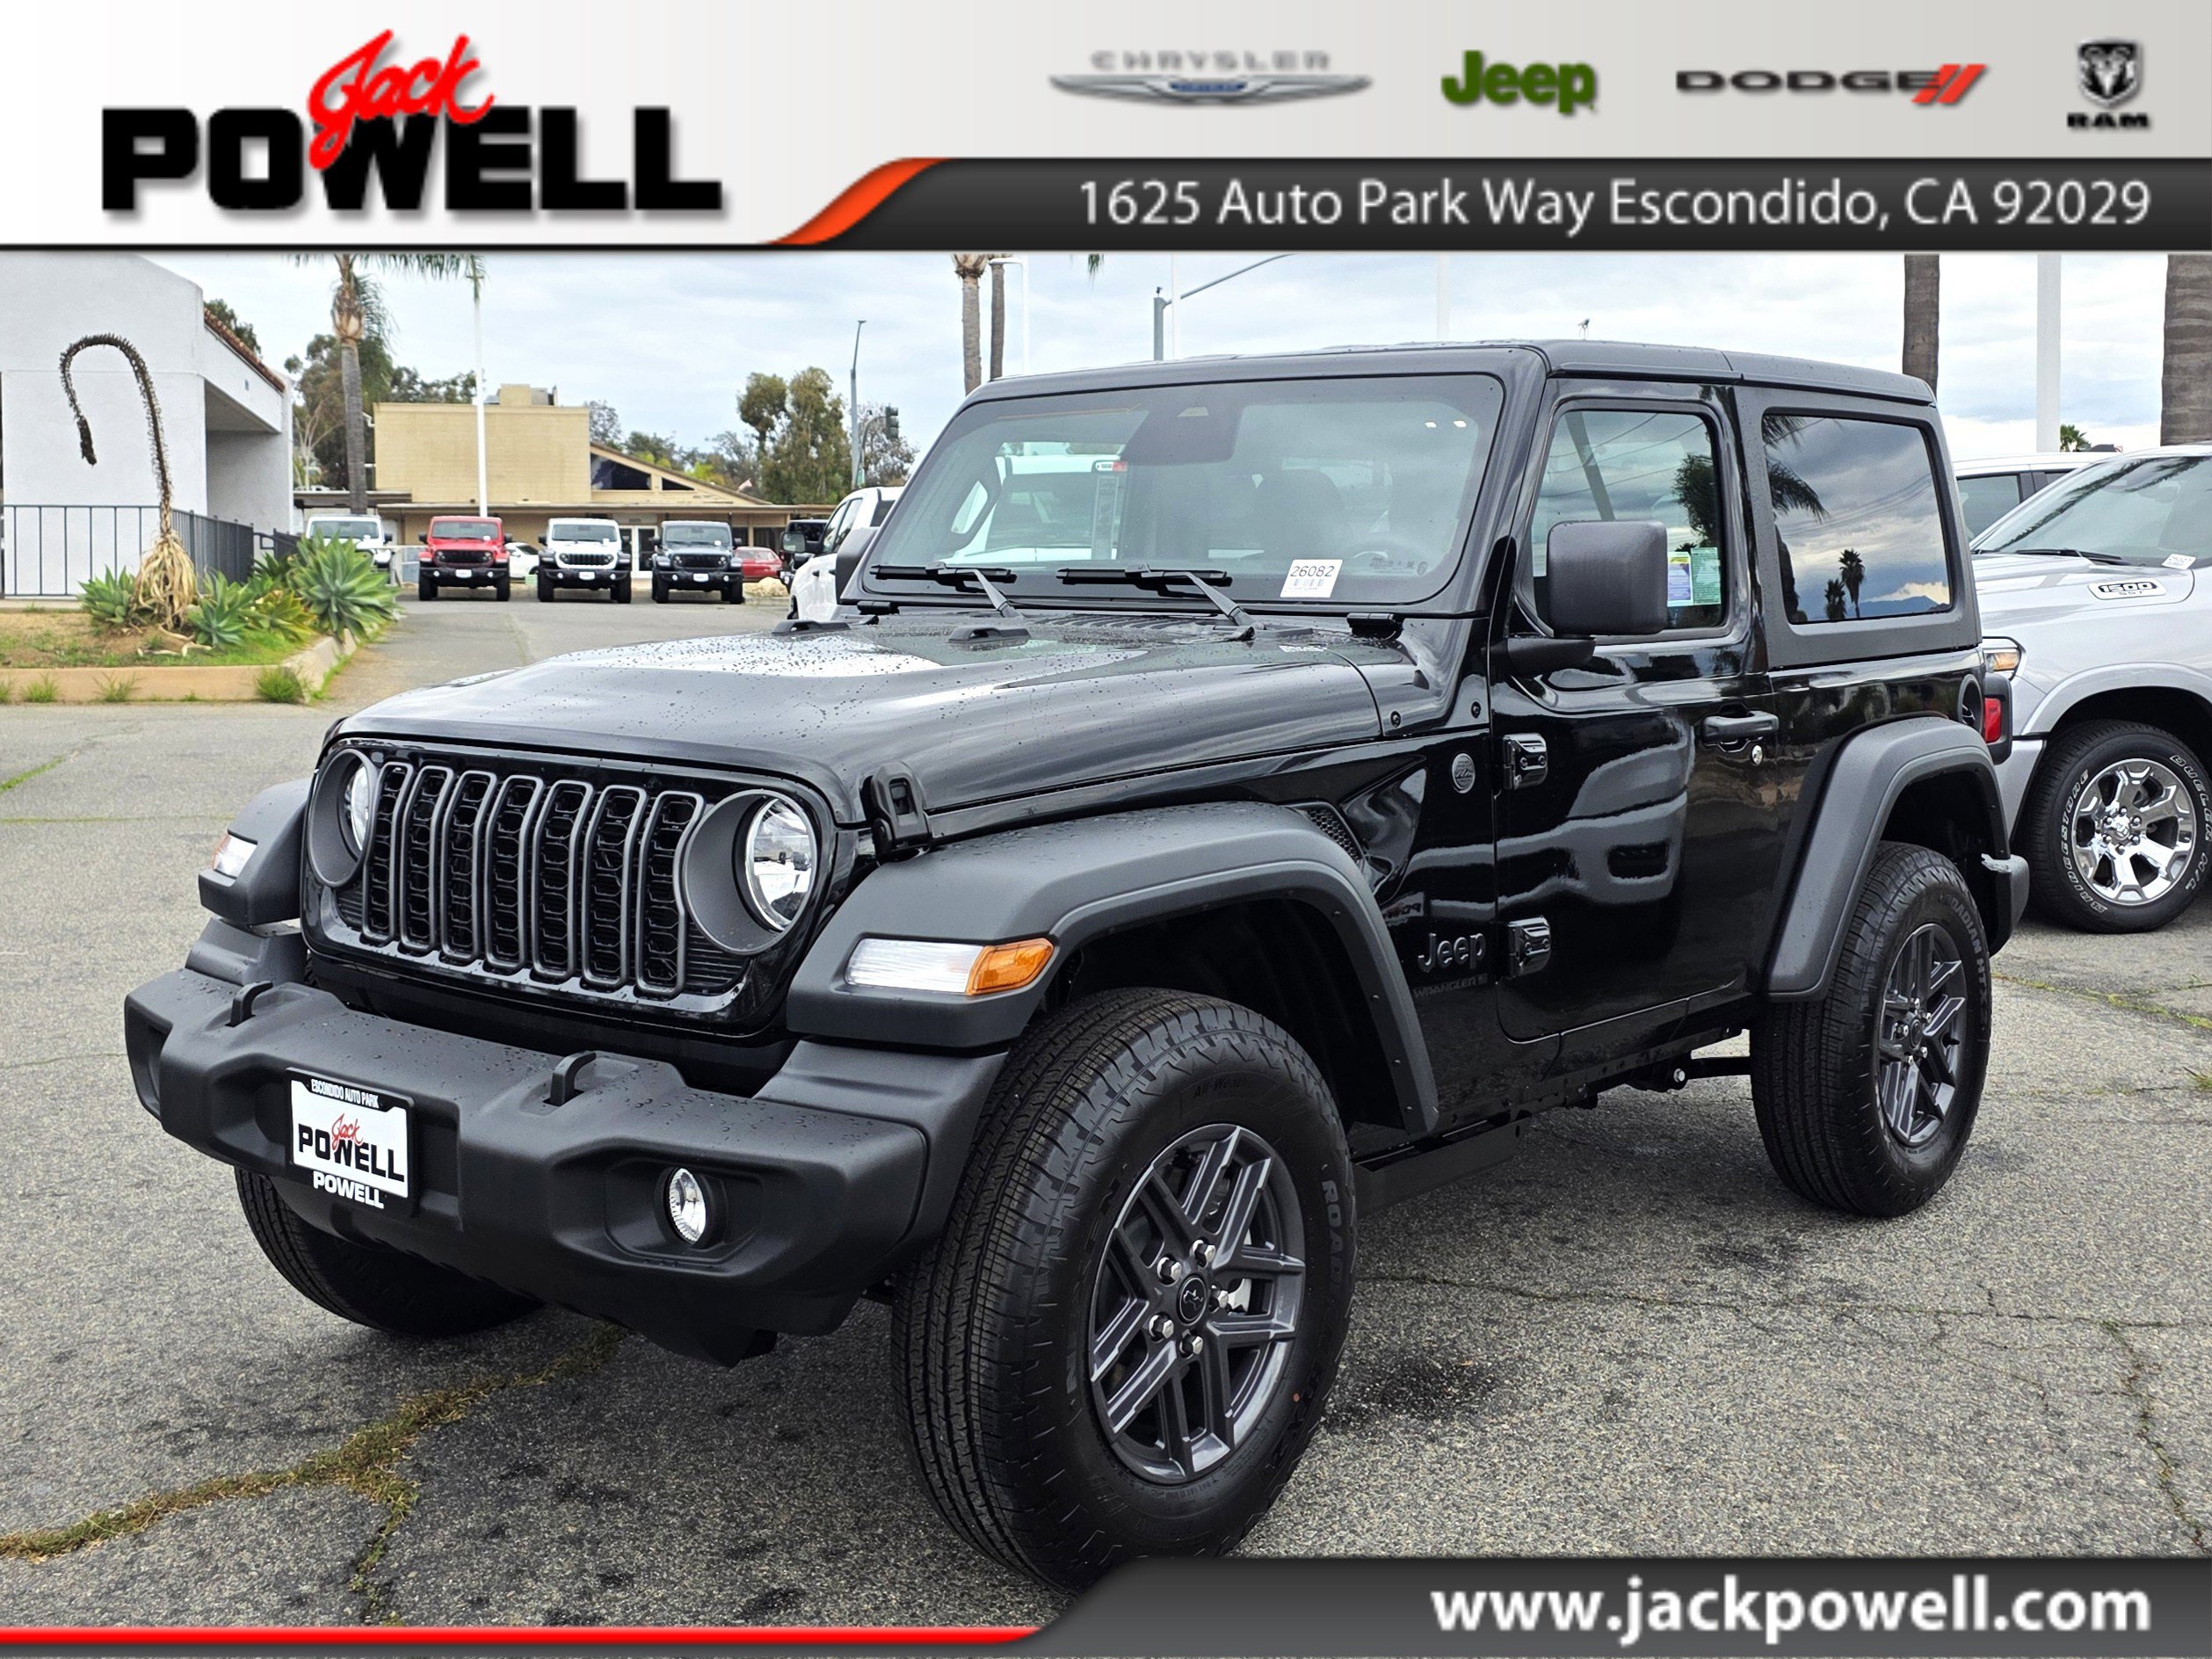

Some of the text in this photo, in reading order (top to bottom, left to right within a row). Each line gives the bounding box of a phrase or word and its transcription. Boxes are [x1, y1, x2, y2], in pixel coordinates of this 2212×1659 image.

[1290, 565, 1335, 577] 26082
[2099, 582, 2157, 593] 1500
[1418, 932, 1487, 973] Jeep
[310, 1078, 380, 1108] ESCONDIDO AUTO PARK
[331, 1112, 363, 1151] Jack
[298, 1123, 405, 1183] POWELL
[313, 1170, 385, 1209] POWELL
